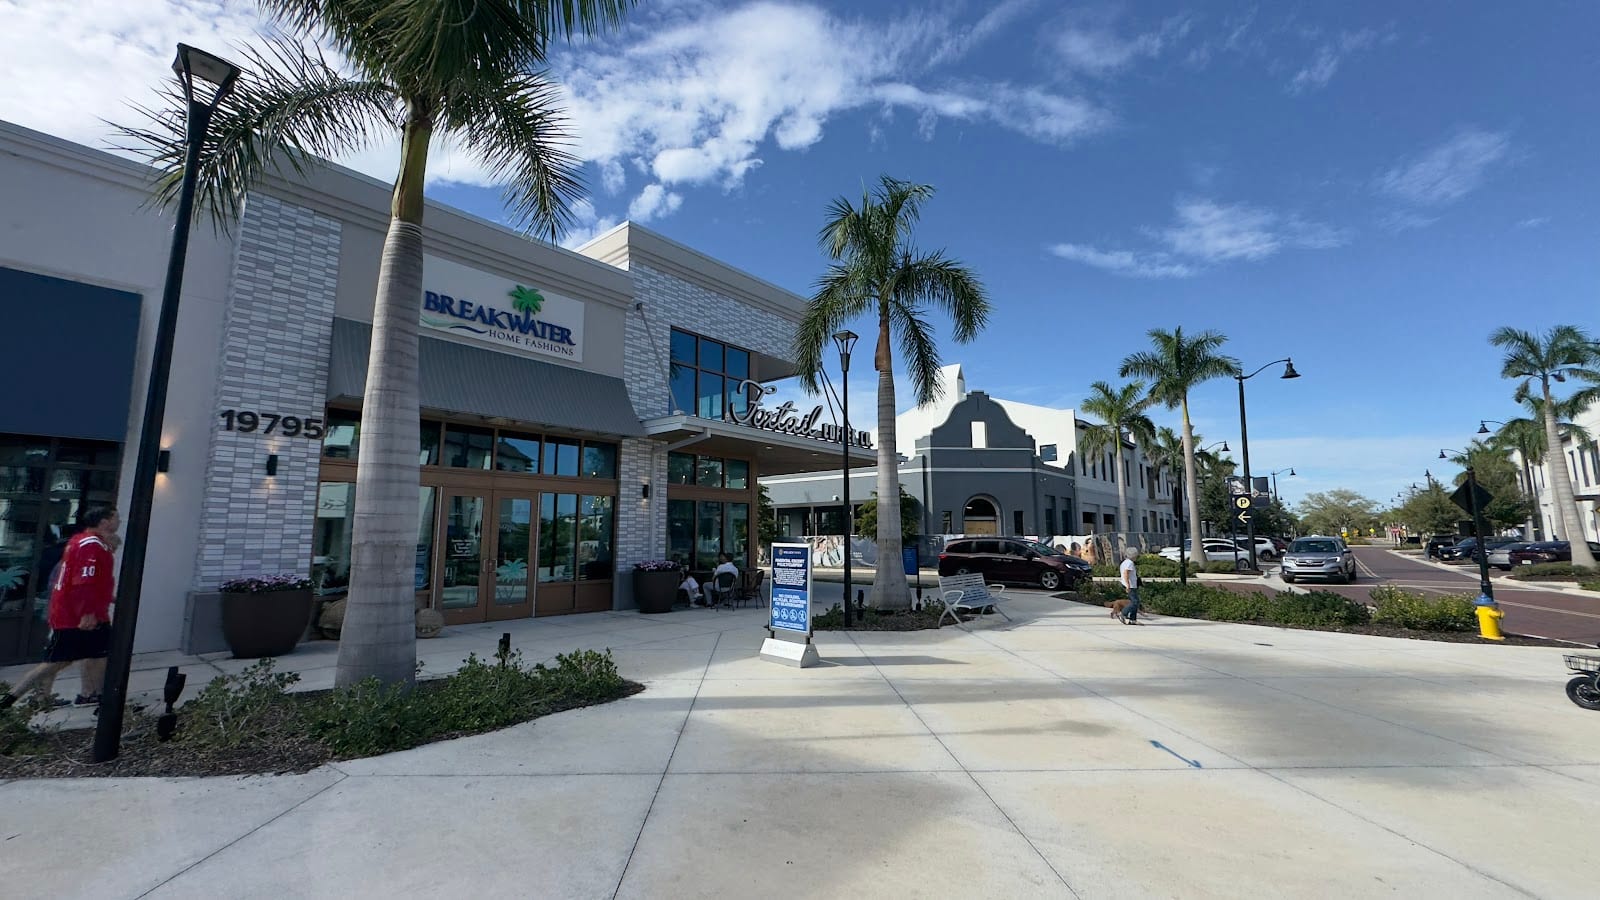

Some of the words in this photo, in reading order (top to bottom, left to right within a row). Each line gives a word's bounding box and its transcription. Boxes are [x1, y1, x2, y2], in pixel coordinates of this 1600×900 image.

[424, 290, 576, 346] BREAKWATER
[489, 329, 521, 344] HOME
[525, 338, 574, 356] FASHIONS
[730, 380, 823, 435] Foxtail
[221, 409, 323, 439] 19795
[81, 565, 95, 577] 10
